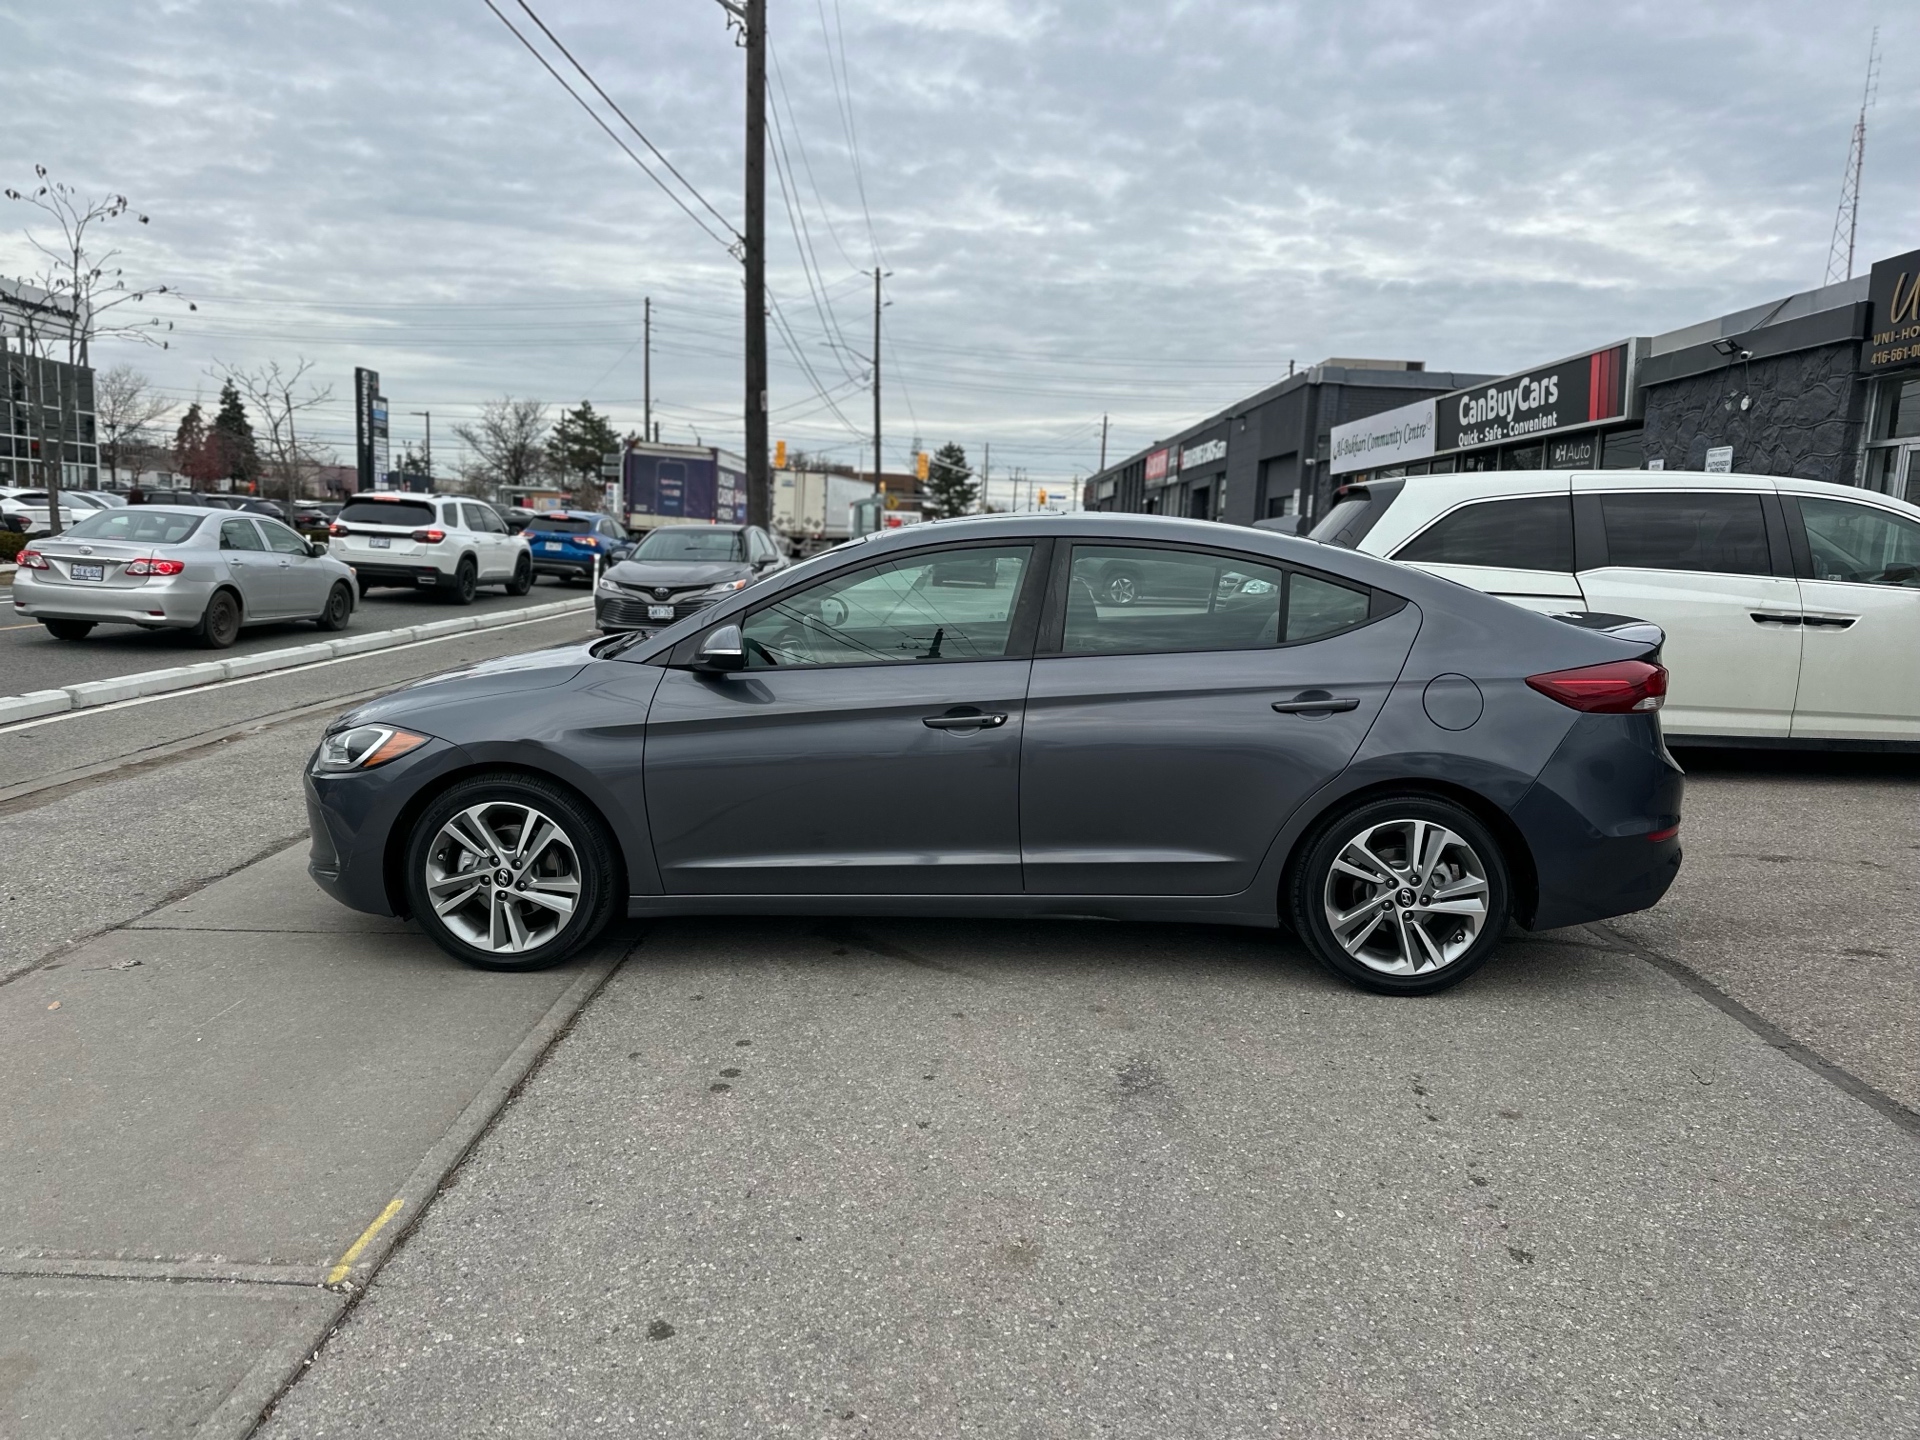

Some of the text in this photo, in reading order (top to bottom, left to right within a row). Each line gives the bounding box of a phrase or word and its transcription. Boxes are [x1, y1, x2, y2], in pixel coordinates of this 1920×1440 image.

[1459, 375, 1558, 426] CanBuyCars
[1333, 423, 1427, 460] Al-Bukhari Community Centre
[1458, 429, 1478, 448] Quick
[1485, 424, 1502, 442] Safe
[1509, 411, 1557, 436] Convenient
[1566, 443, 1591, 460] Auto
[1708, 460, 1730, 468] AUTHORIZED
